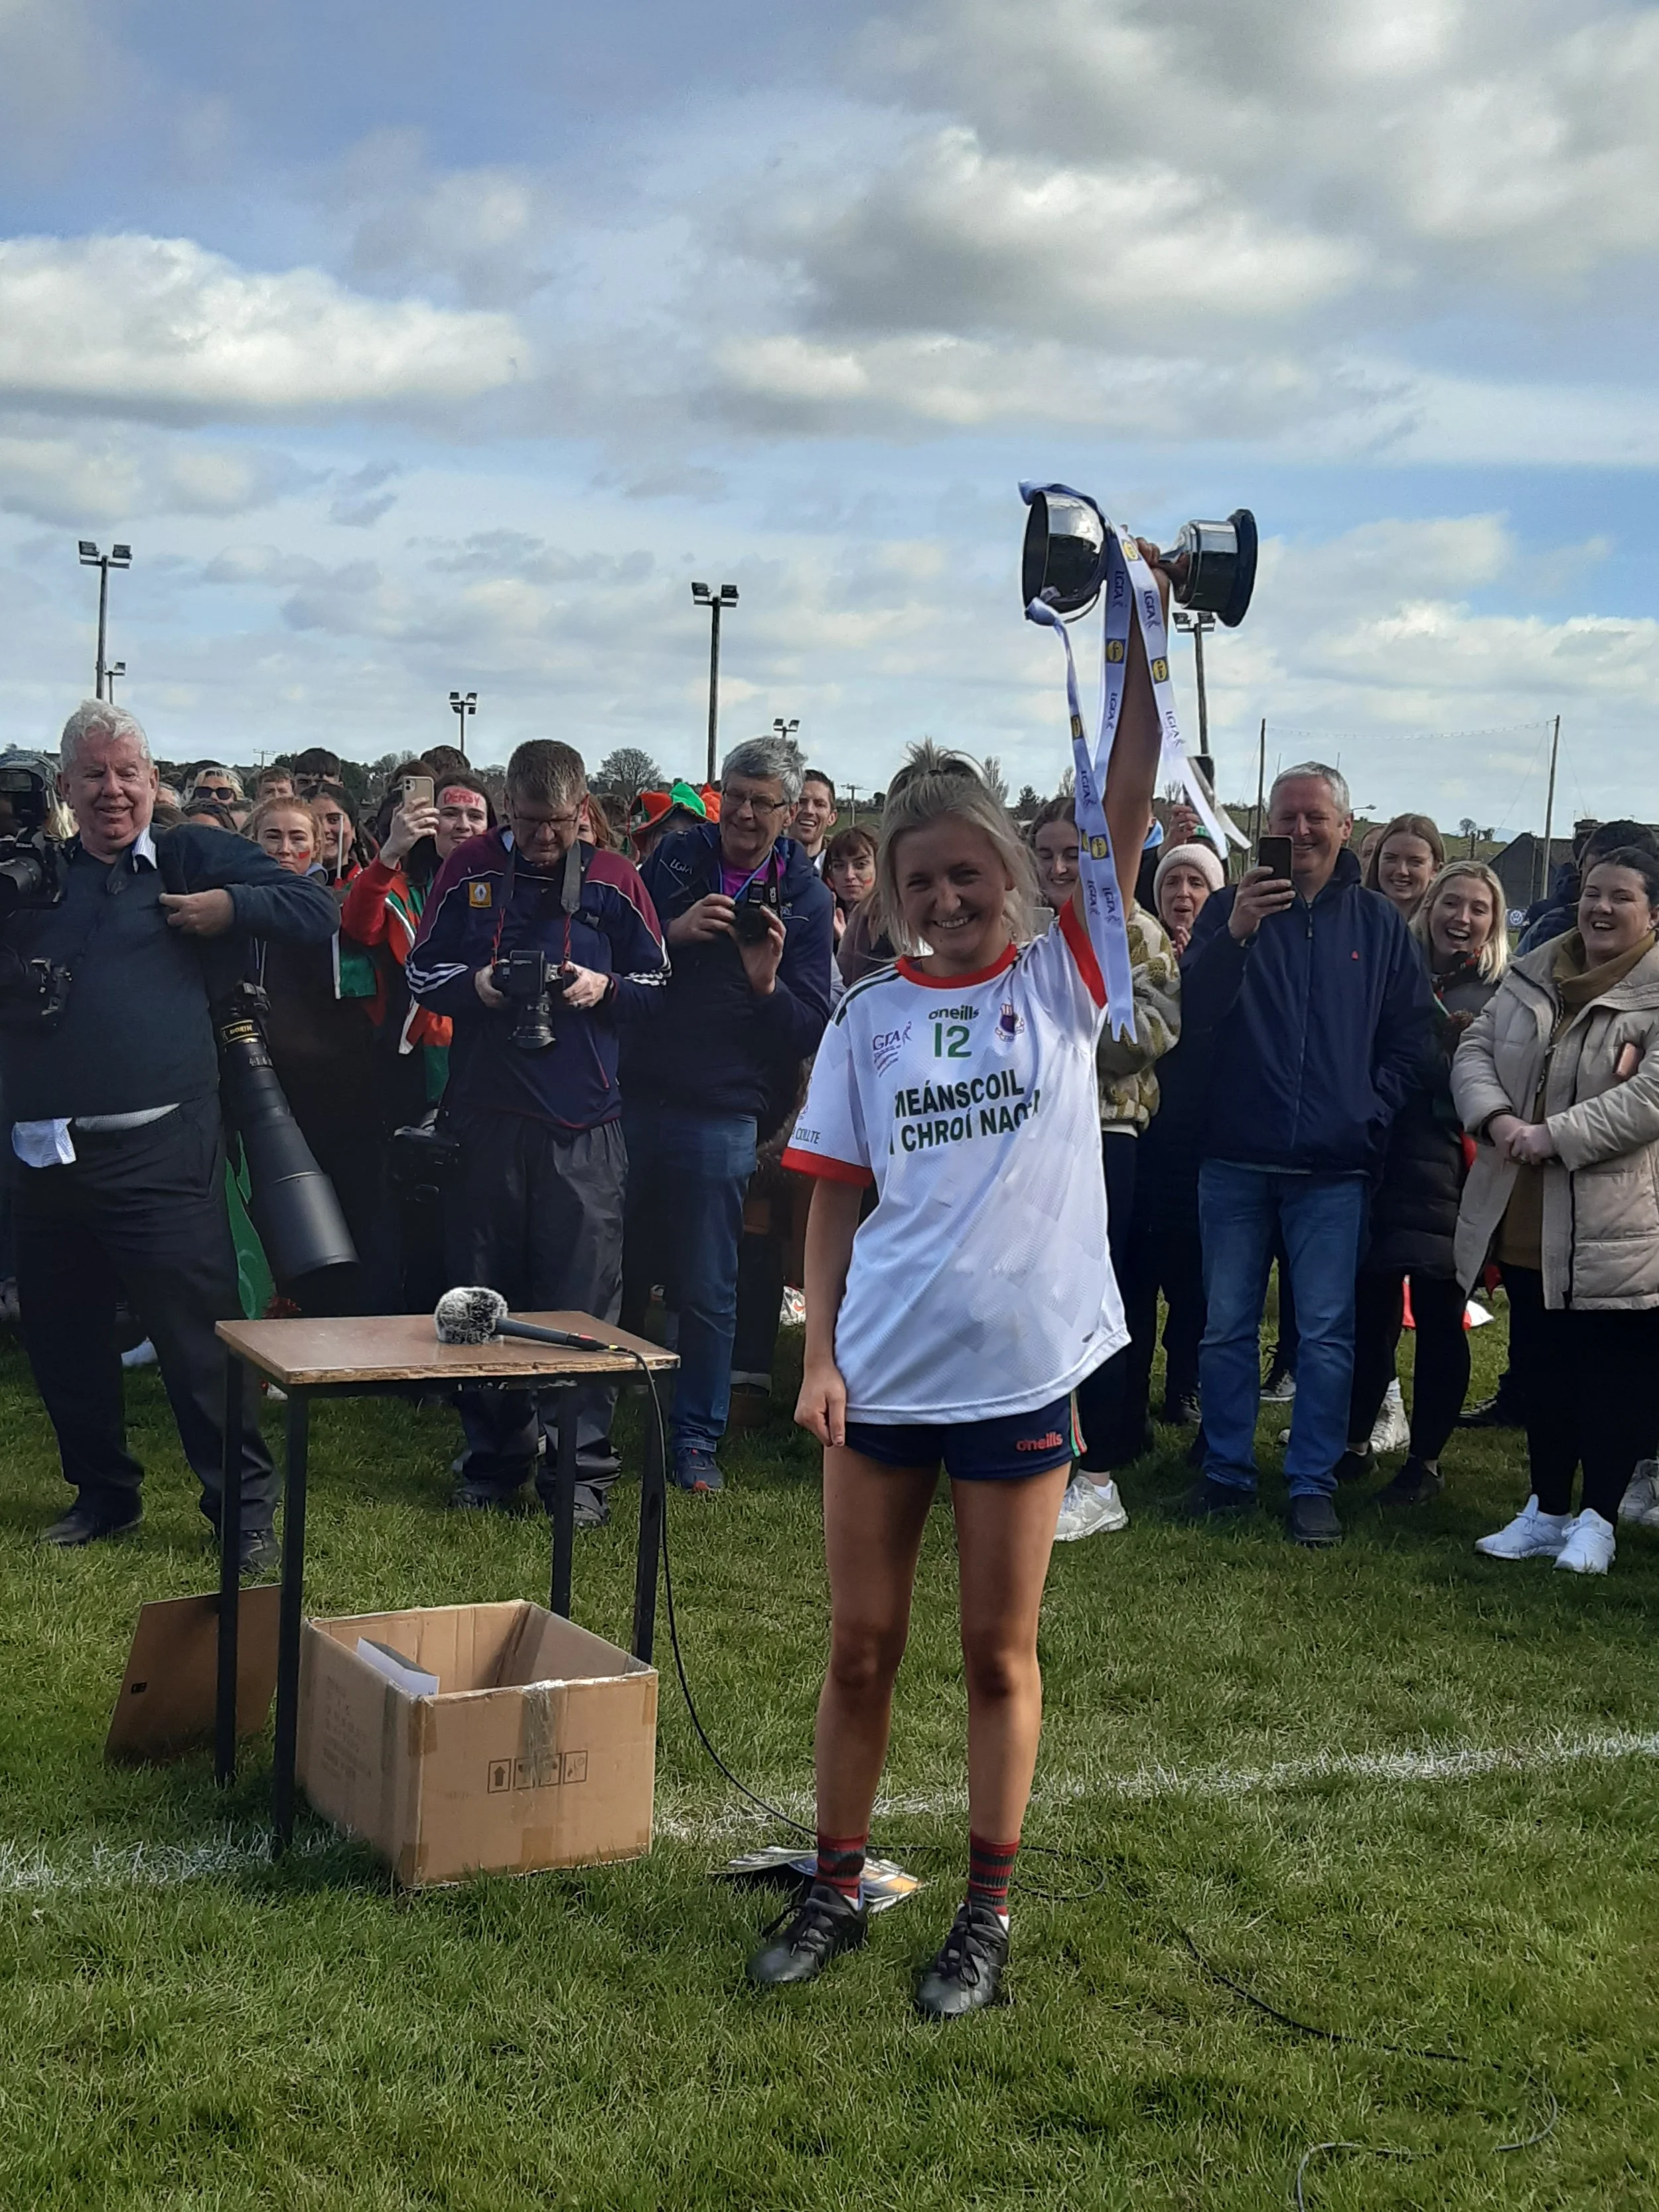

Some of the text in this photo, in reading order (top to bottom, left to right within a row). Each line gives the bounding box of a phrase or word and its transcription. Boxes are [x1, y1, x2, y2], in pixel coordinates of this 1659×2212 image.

[873, 1030, 901, 1051] GFA
[934, 1022, 973, 1058] 12
[895, 1069, 1025, 1119] MEÁNSCOIL
[901, 1107, 973, 1153] CHROÍ
